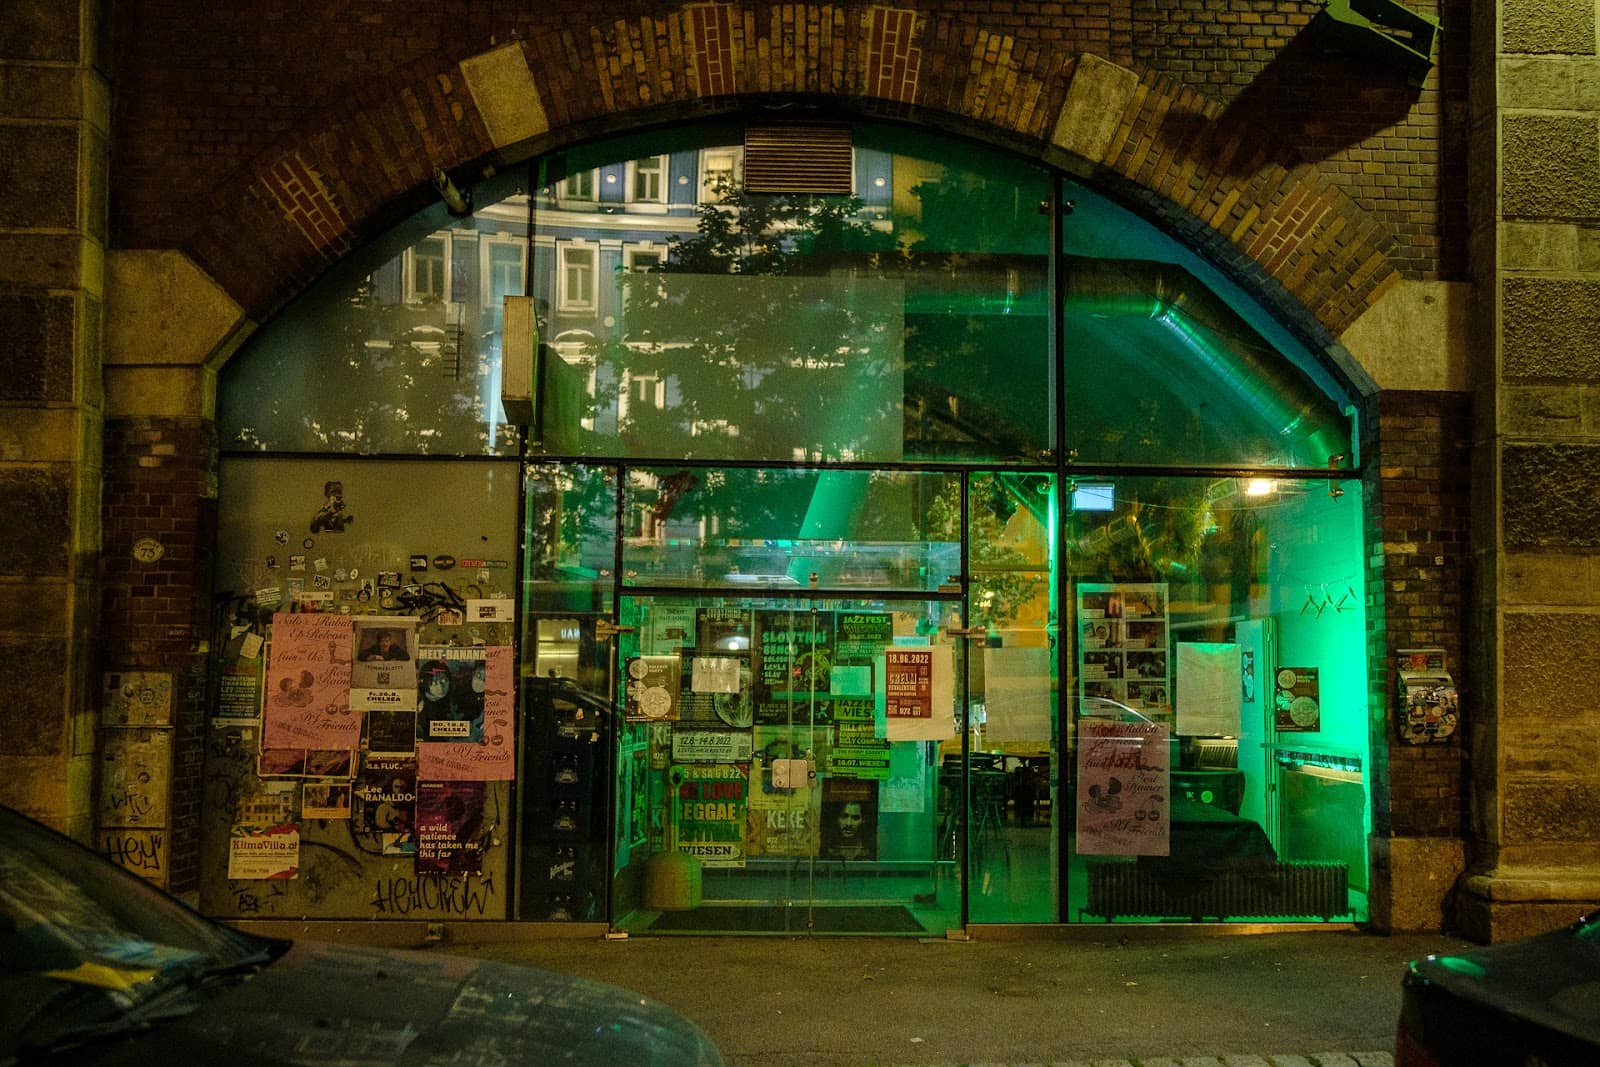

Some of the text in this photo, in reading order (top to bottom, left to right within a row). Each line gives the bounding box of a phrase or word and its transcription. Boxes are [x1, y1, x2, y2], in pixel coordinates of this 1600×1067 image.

[843, 615, 887, 624] JAZZ FEST
[889, 654, 929, 664] 18.06.2022
[365, 785, 382, 793] Lee
[703, 782, 743, 800] LOVE
[366, 793, 412, 802] RANALDO
[429, 823, 448, 832] wild
[420, 832, 457, 843] patience
[419, 841, 436, 849] has
[437, 841, 463, 849] taken
[419, 849, 452, 860] this far
